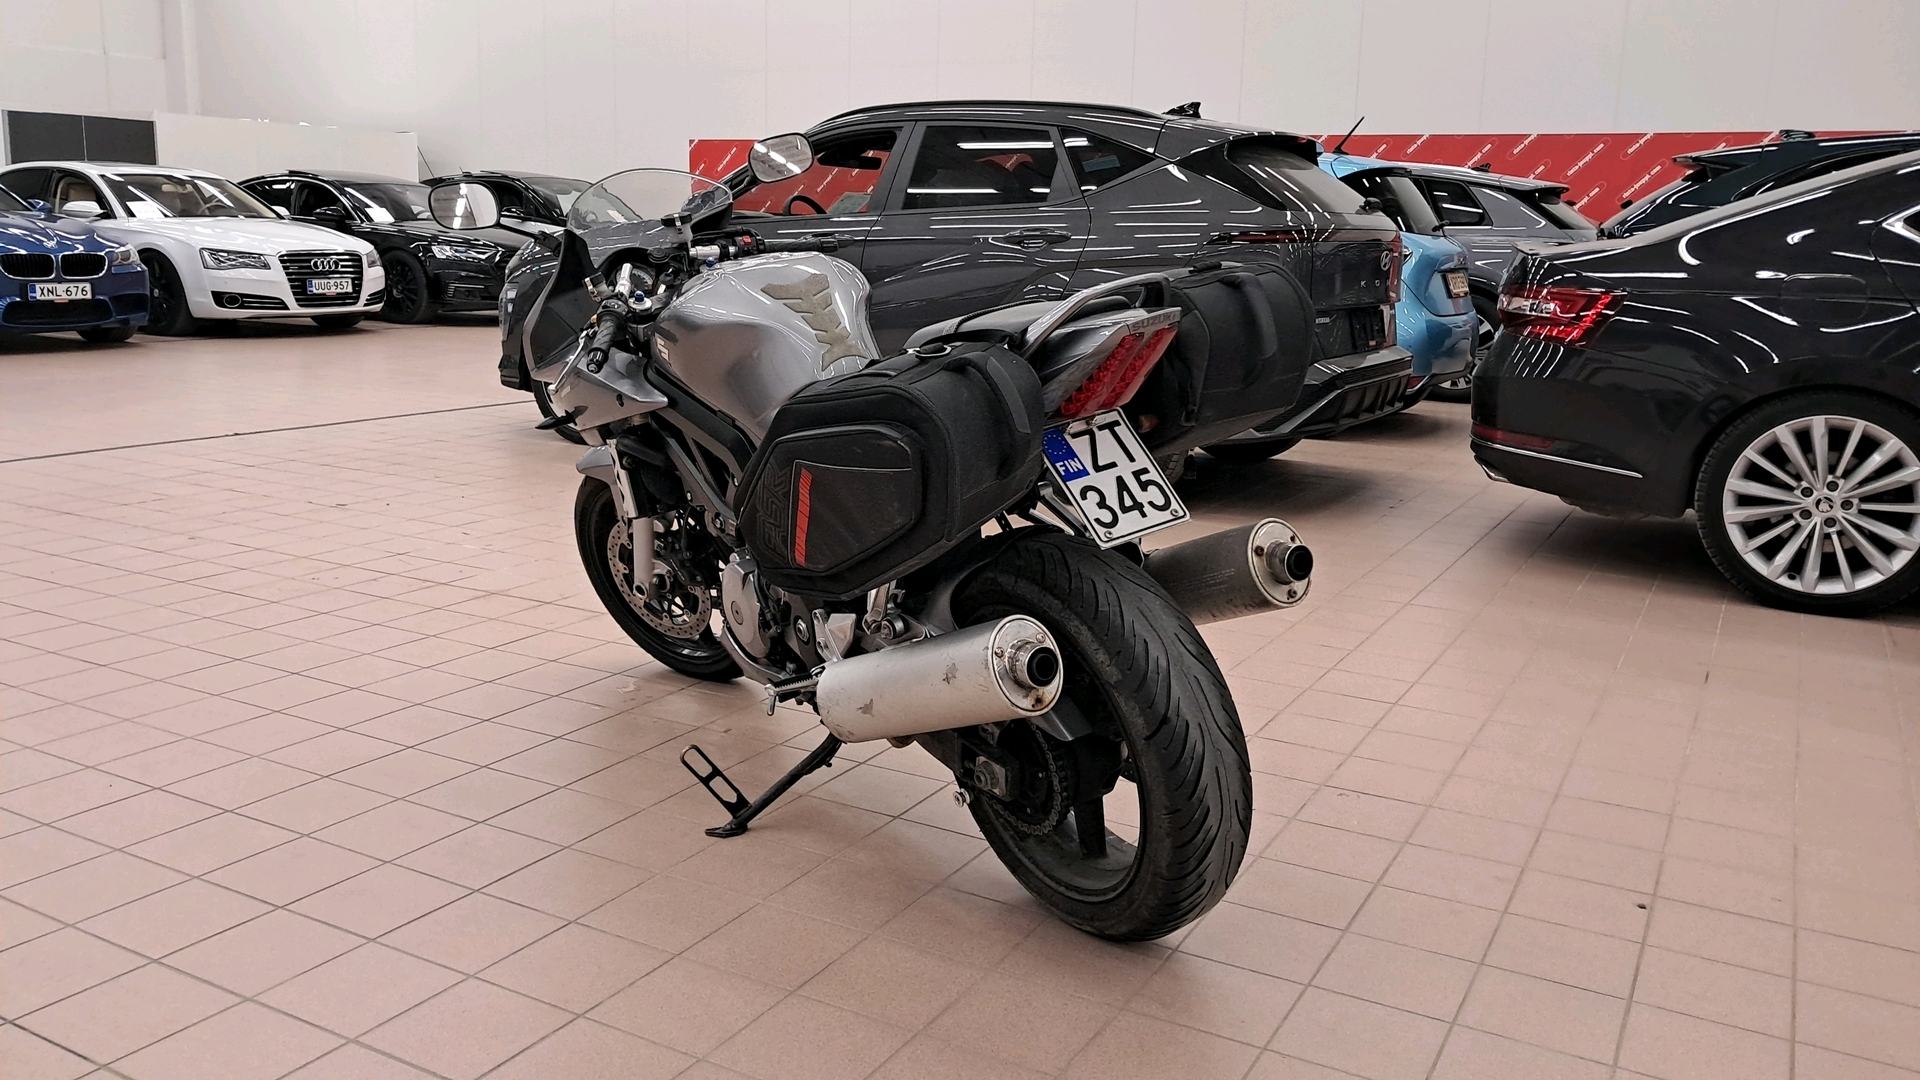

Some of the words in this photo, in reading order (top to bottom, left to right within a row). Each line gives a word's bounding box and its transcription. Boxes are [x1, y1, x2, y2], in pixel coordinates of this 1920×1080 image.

[39, 286, 88, 297] XNL-676
[314, 281, 350, 291] UUG-957
[1131, 312, 1177, 332] SUZUKI
[1070, 419, 1137, 473] ZT
[1055, 457, 1084, 476] FIN
[1080, 467, 1172, 529] 345
